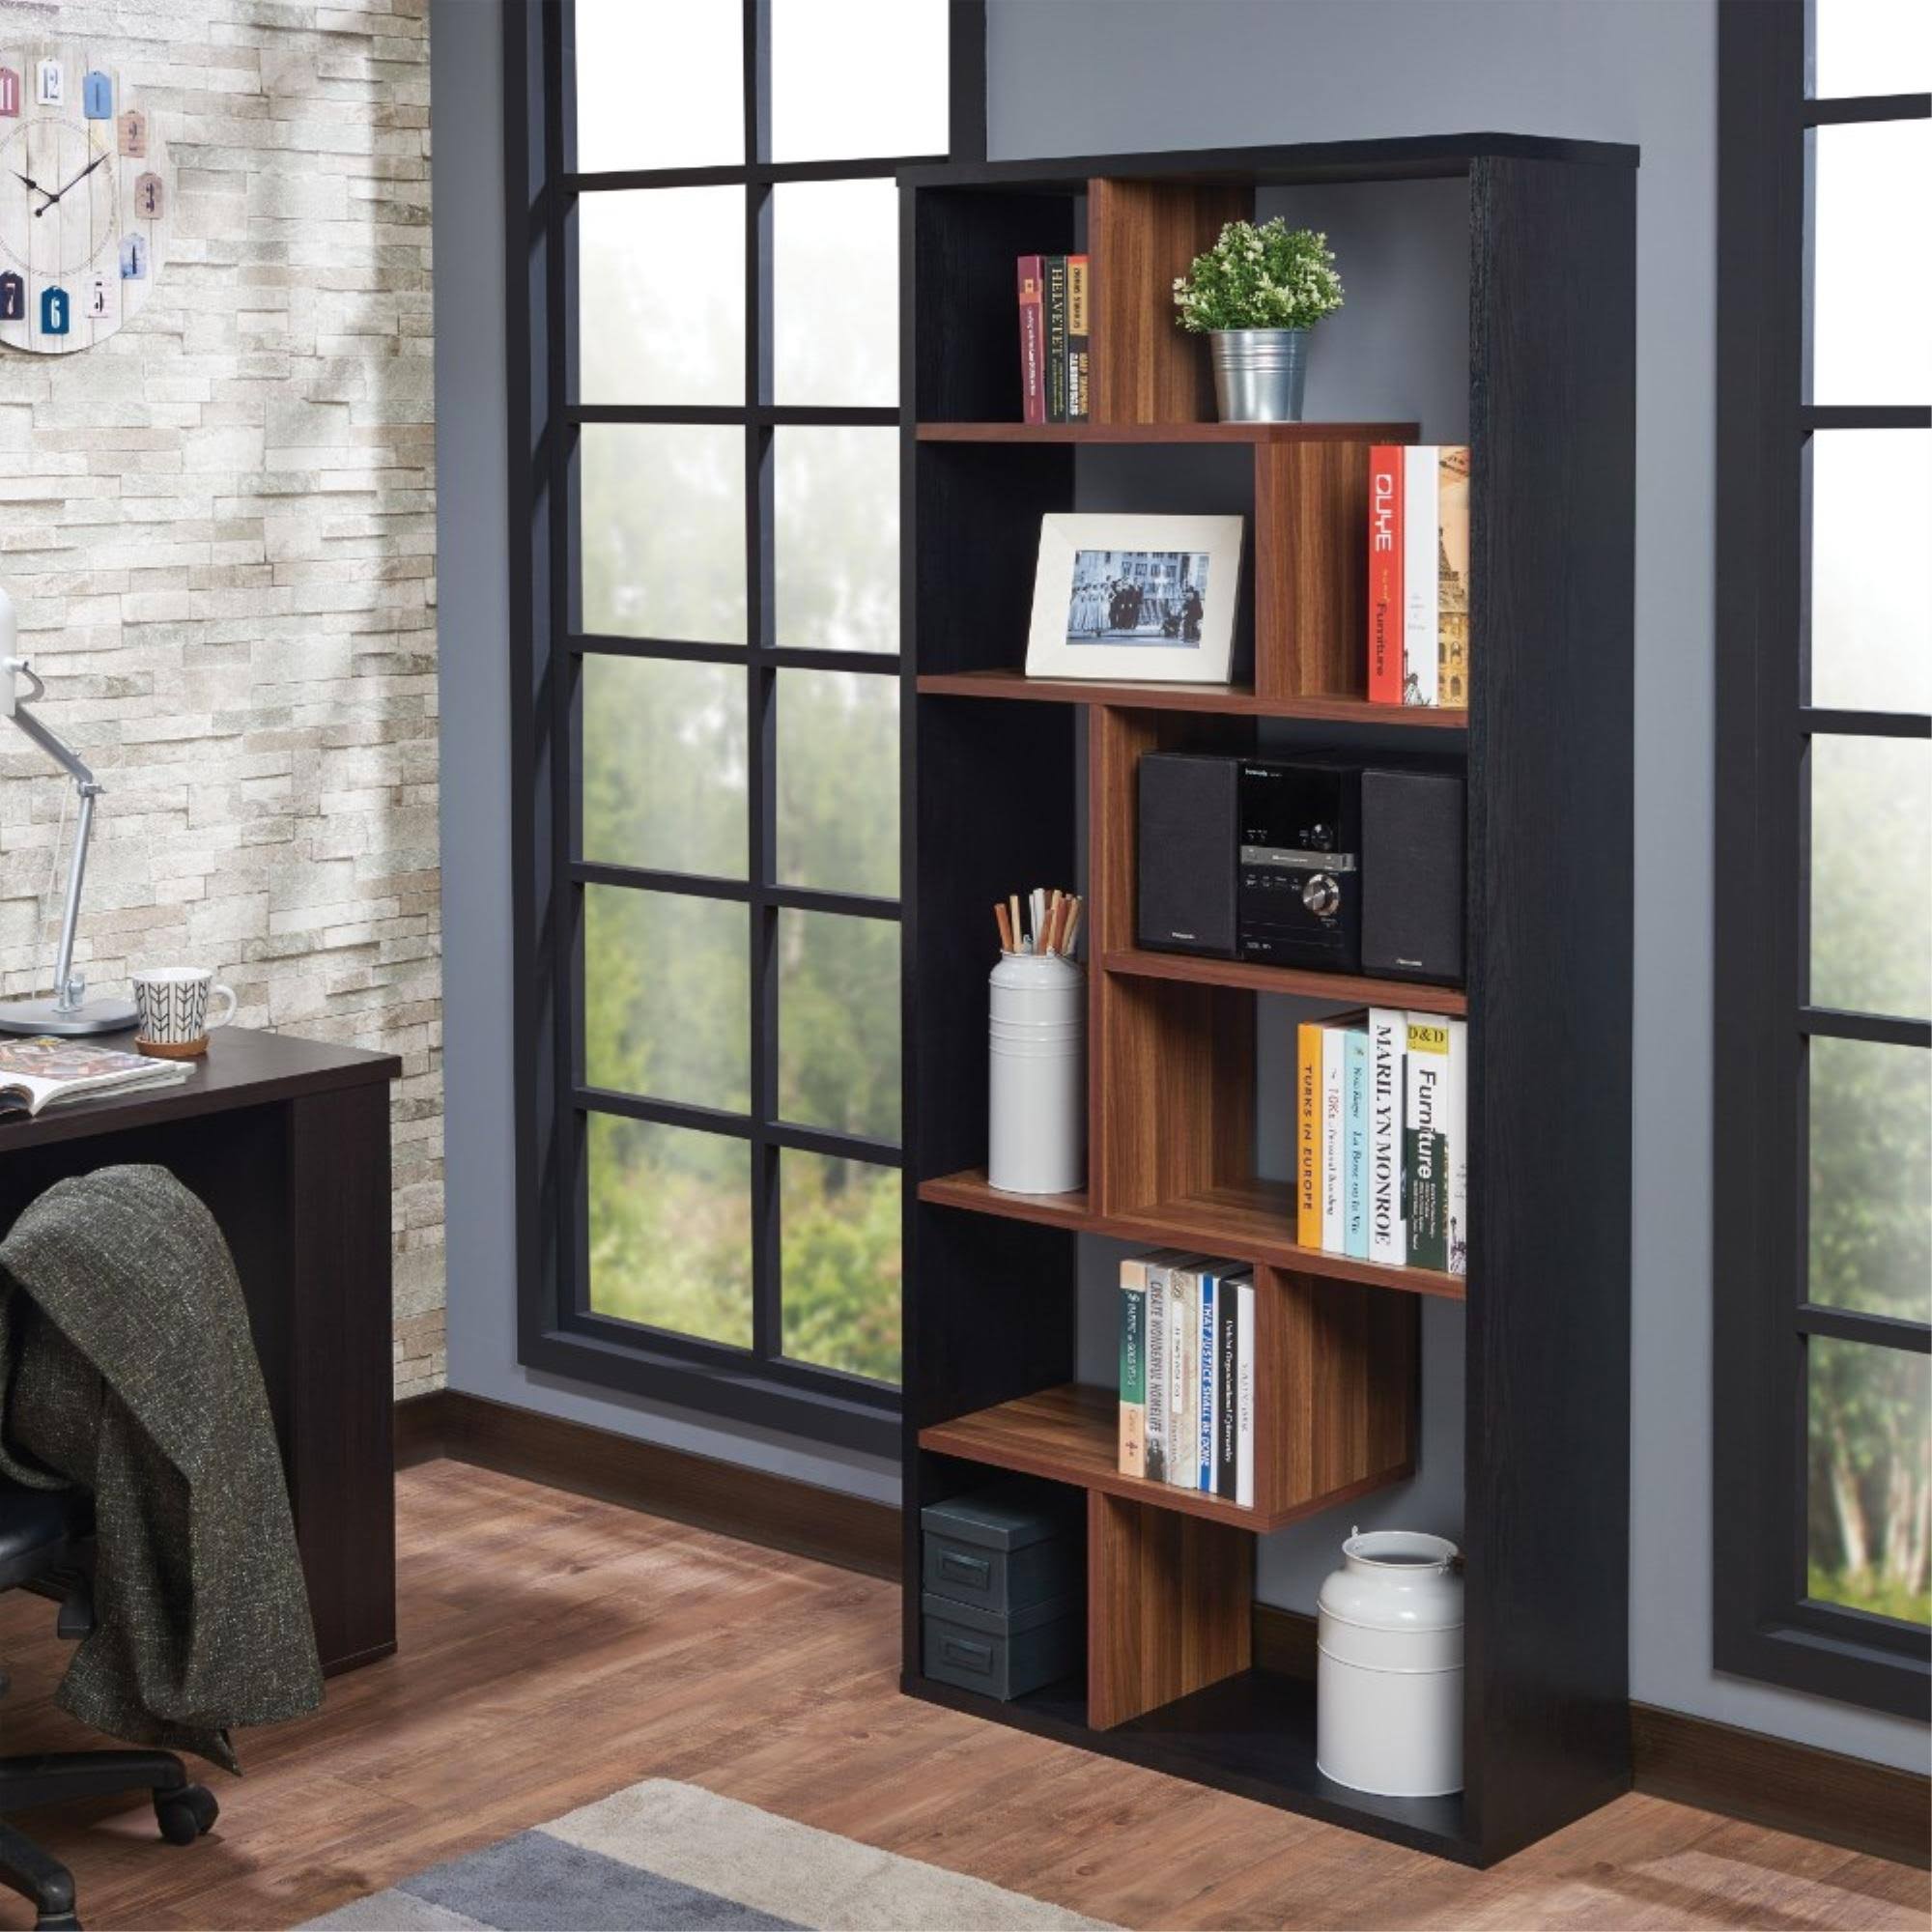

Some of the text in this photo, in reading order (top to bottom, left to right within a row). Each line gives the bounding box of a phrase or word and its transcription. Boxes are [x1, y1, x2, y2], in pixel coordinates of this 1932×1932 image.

[43, 68, 59, 99] 12
[95, 83, 101, 112] 1
[5, 282, 15, 316] 7
[50, 297, 61, 329] 6
[1376, 603, 1387, 676] Furniture
[1303, 1065, 1313, 1210] TURKS IN EUROPE
[1376, 1025, 1392, 1245] MARILYN MONROE
[1417, 1069, 1436, 1179] Furniture
